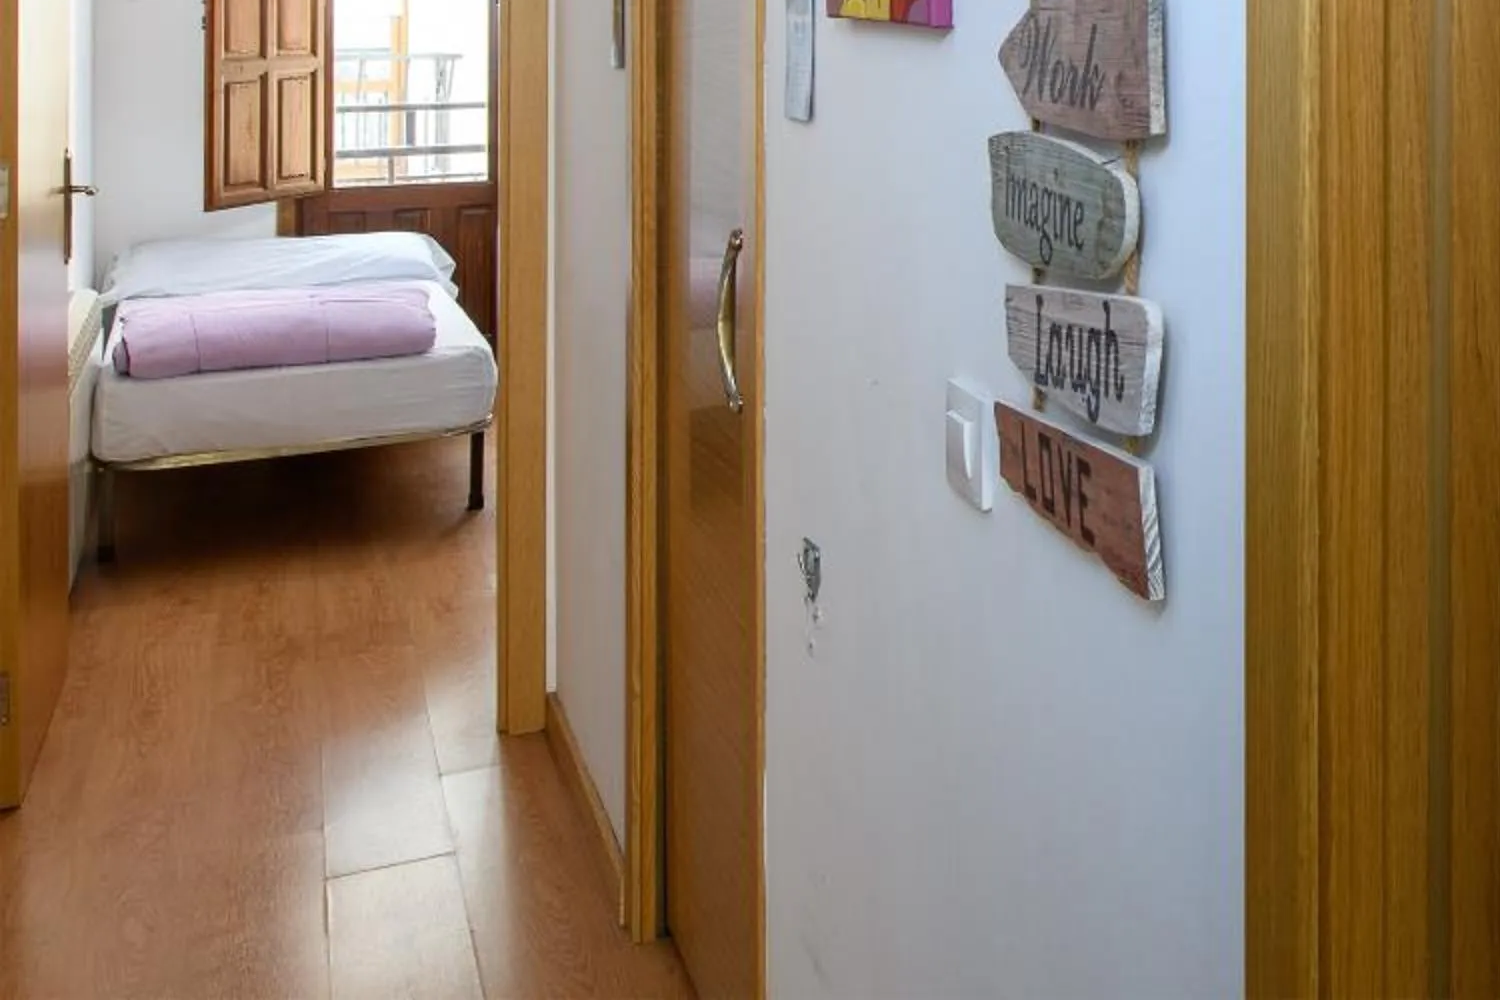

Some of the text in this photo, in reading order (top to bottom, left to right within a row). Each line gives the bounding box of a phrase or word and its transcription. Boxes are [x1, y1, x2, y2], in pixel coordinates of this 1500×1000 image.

[1018, 18, 1105, 104] Work
[1034, 295, 1125, 423] Laugh
[1018, 419, 1096, 547] LOVE
